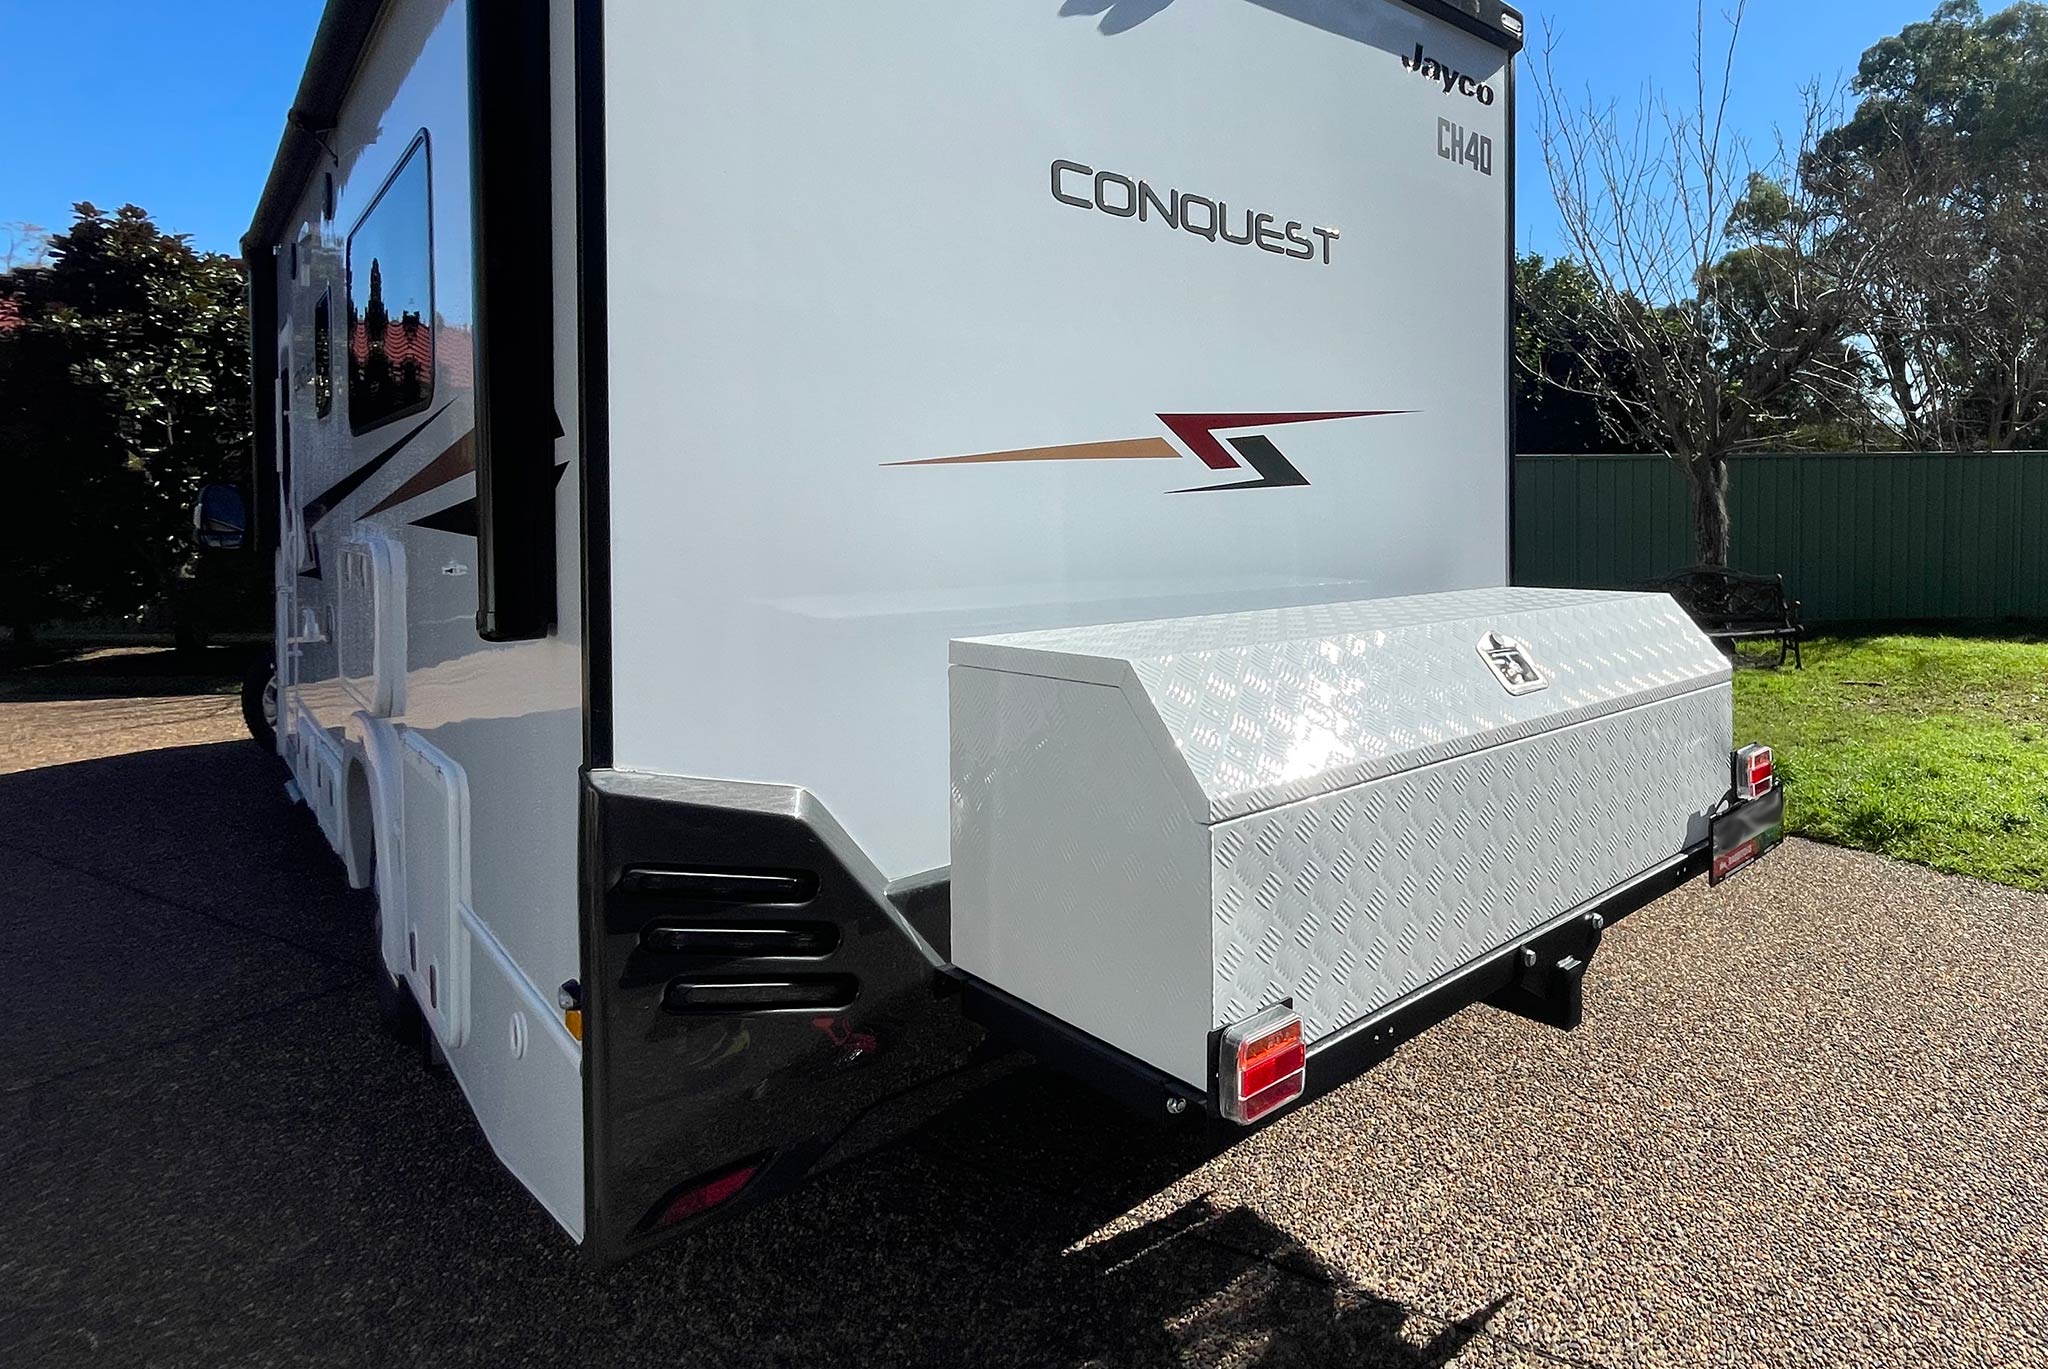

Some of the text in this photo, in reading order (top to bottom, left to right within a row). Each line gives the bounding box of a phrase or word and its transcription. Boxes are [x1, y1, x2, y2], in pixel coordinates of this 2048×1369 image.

[1401, 42, 1494, 106] Jayco
[1437, 117, 1492, 176] CH40
[1051, 159, 1340, 265] CONQUEST
